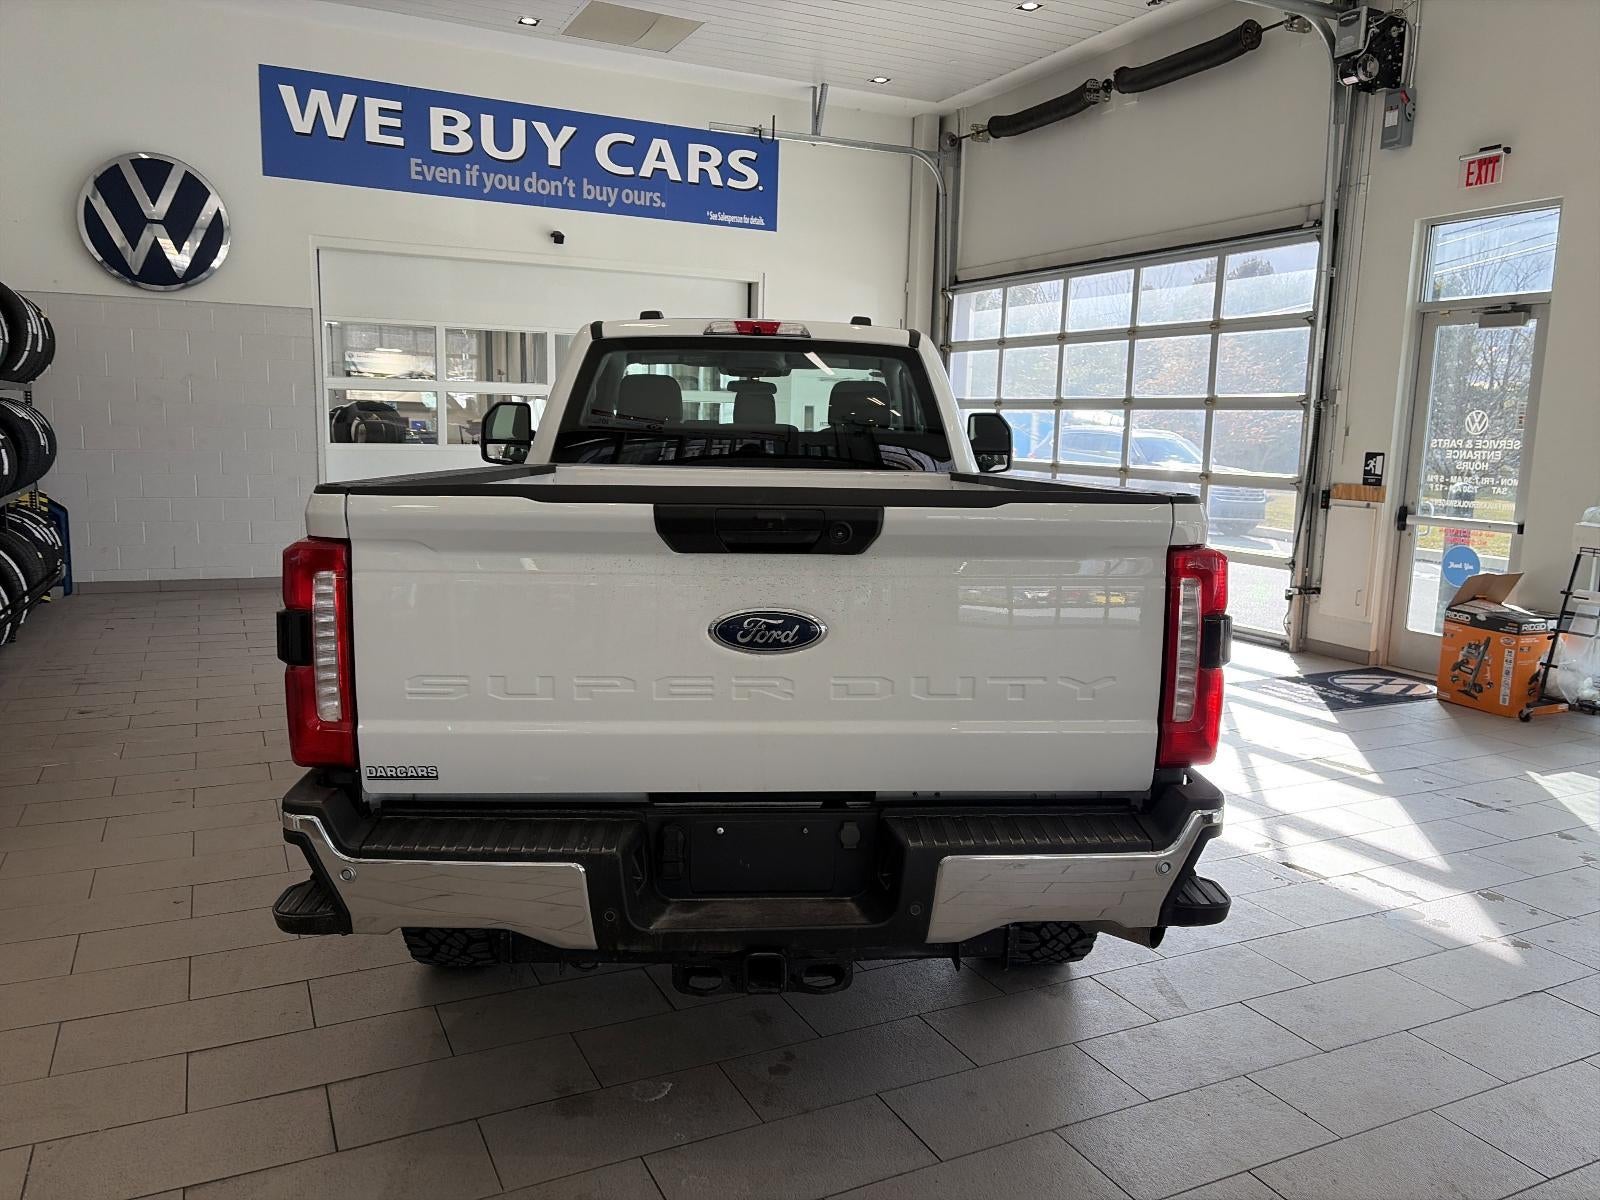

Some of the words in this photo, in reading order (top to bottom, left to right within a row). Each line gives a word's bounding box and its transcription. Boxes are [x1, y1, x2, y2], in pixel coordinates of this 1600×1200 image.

[278, 84, 405, 148] WE
[429, 106, 577, 168] BUY
[594, 132, 764, 191] CARS.
[410, 158, 461, 185] Even
[465, 163, 480, 187] if
[481, 171, 520, 194] you
[523, 171, 576, 198] don’t
[583, 178, 628, 207] buy
[631, 188, 666, 208] ours.
[1465, 155, 1500, 187] EXIT
[718, 211, 743, 225] Salesperson
[1445, 610, 1471, 621] RIDGID
[1521, 622, 1547, 631] RIDGID
[736, 617, 800, 643] Ford
[405, 674, 795, 701] SUPER
[829, 675, 1117, 701] DUTY
[365, 766, 438, 779] DARCARS
